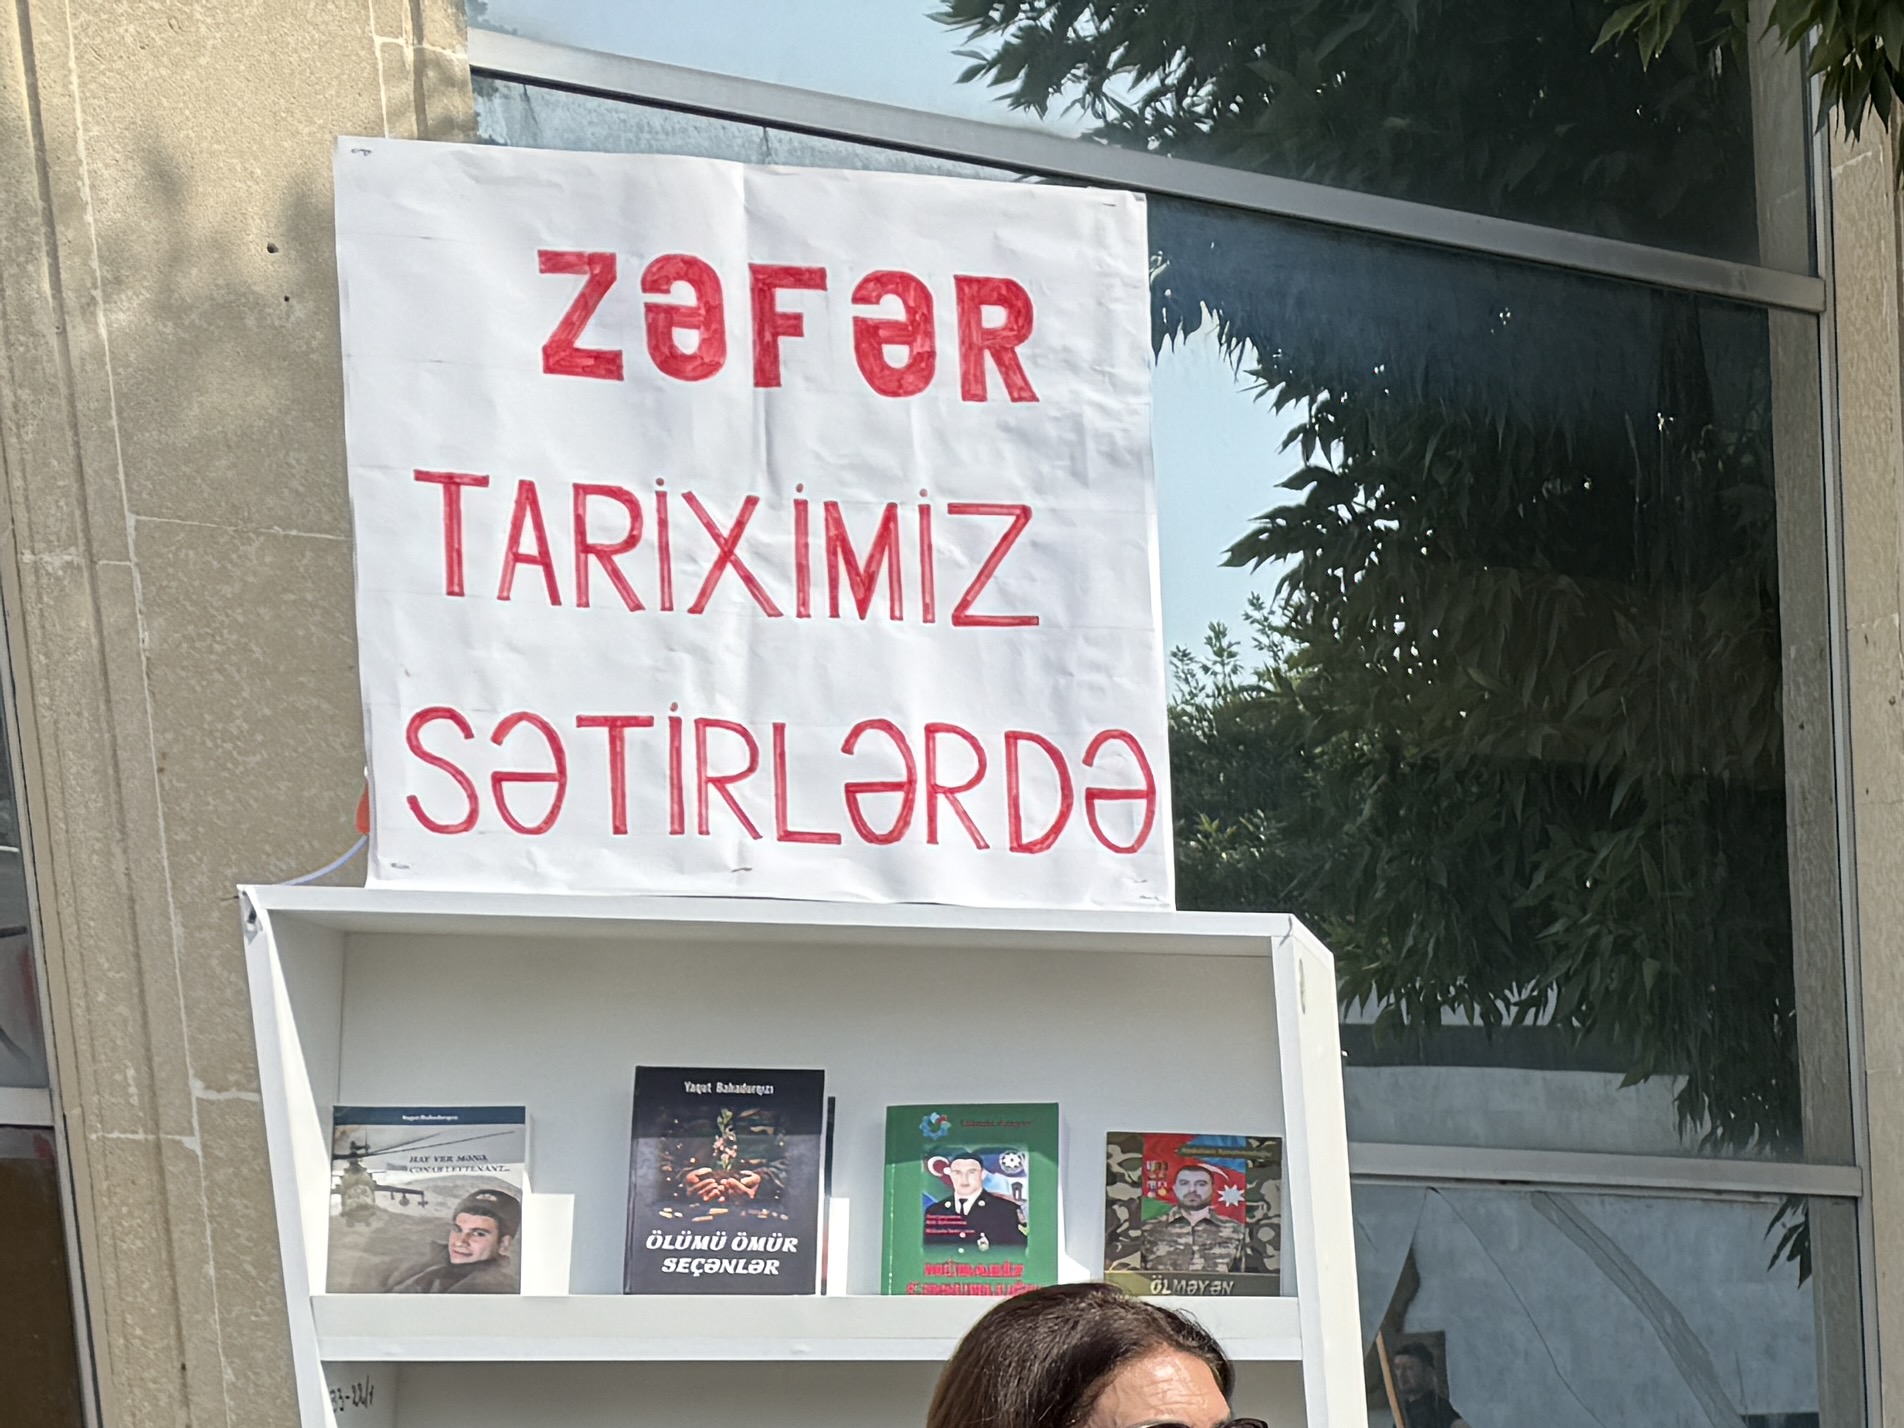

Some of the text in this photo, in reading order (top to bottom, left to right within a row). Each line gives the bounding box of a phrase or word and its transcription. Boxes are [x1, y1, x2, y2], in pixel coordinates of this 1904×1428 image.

[537, 248, 1039, 403] ZƏFƏR
[413, 469, 1040, 627] TARİXİMİZ
[405, 701, 1157, 855] SƏTİRLƏRDƏ
[684, 1081, 712, 1095] Yaqut
[646, 1230, 798, 1252] ÖLÜMÜ ÖMÜR
[661, 1257, 780, 1277] SEÇƏNLƏR
[1150, 1275, 1234, 1294] ÖLMƏYƏN
